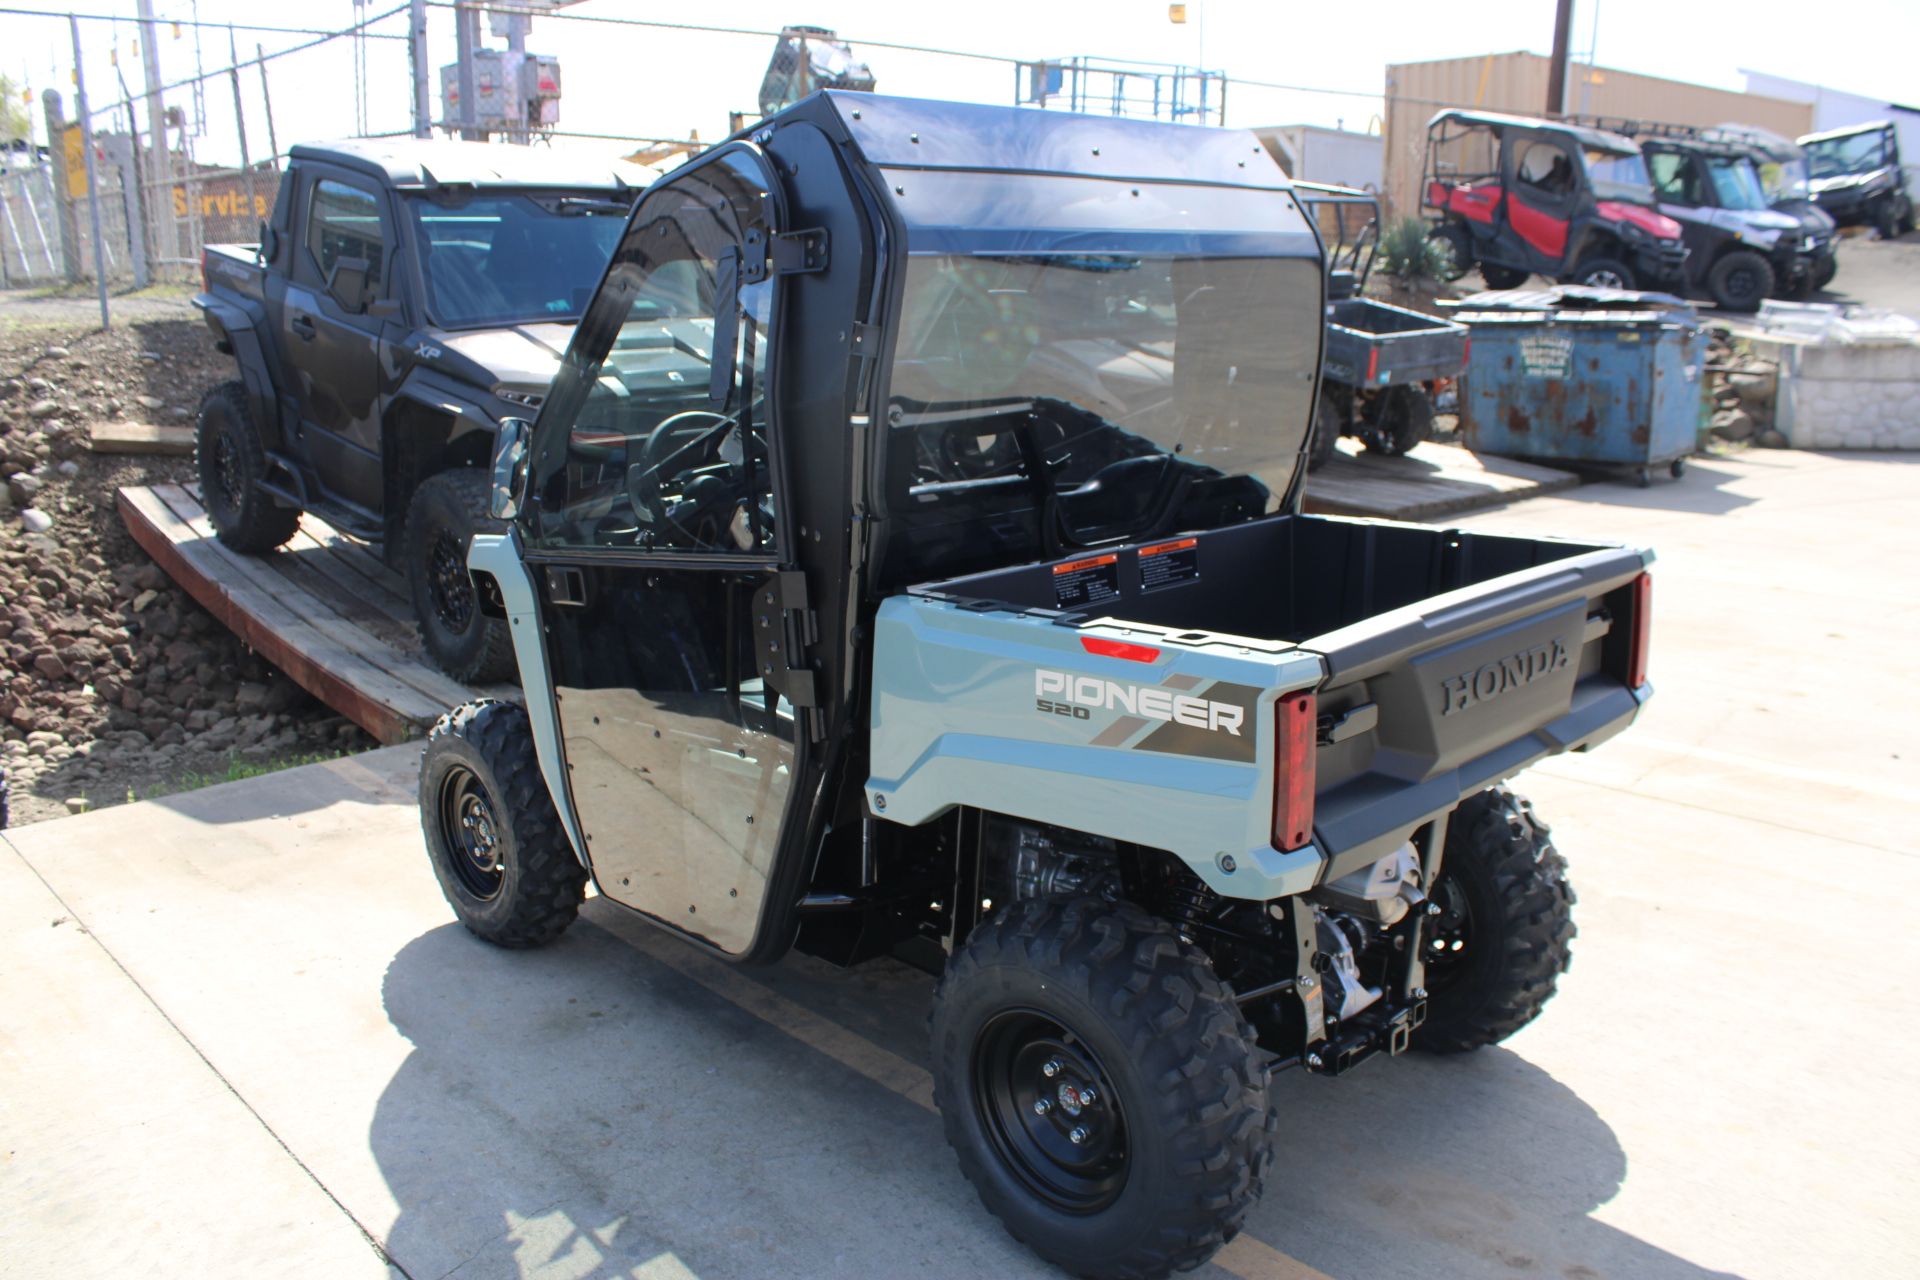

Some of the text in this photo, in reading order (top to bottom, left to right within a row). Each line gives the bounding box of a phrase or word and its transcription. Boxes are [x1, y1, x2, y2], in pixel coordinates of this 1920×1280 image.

[414, 342, 441, 359] XP
[1441, 636, 1571, 716] HONDA
[1035, 668, 1244, 736] PIONEER
[1036, 699, 1090, 721] 520
